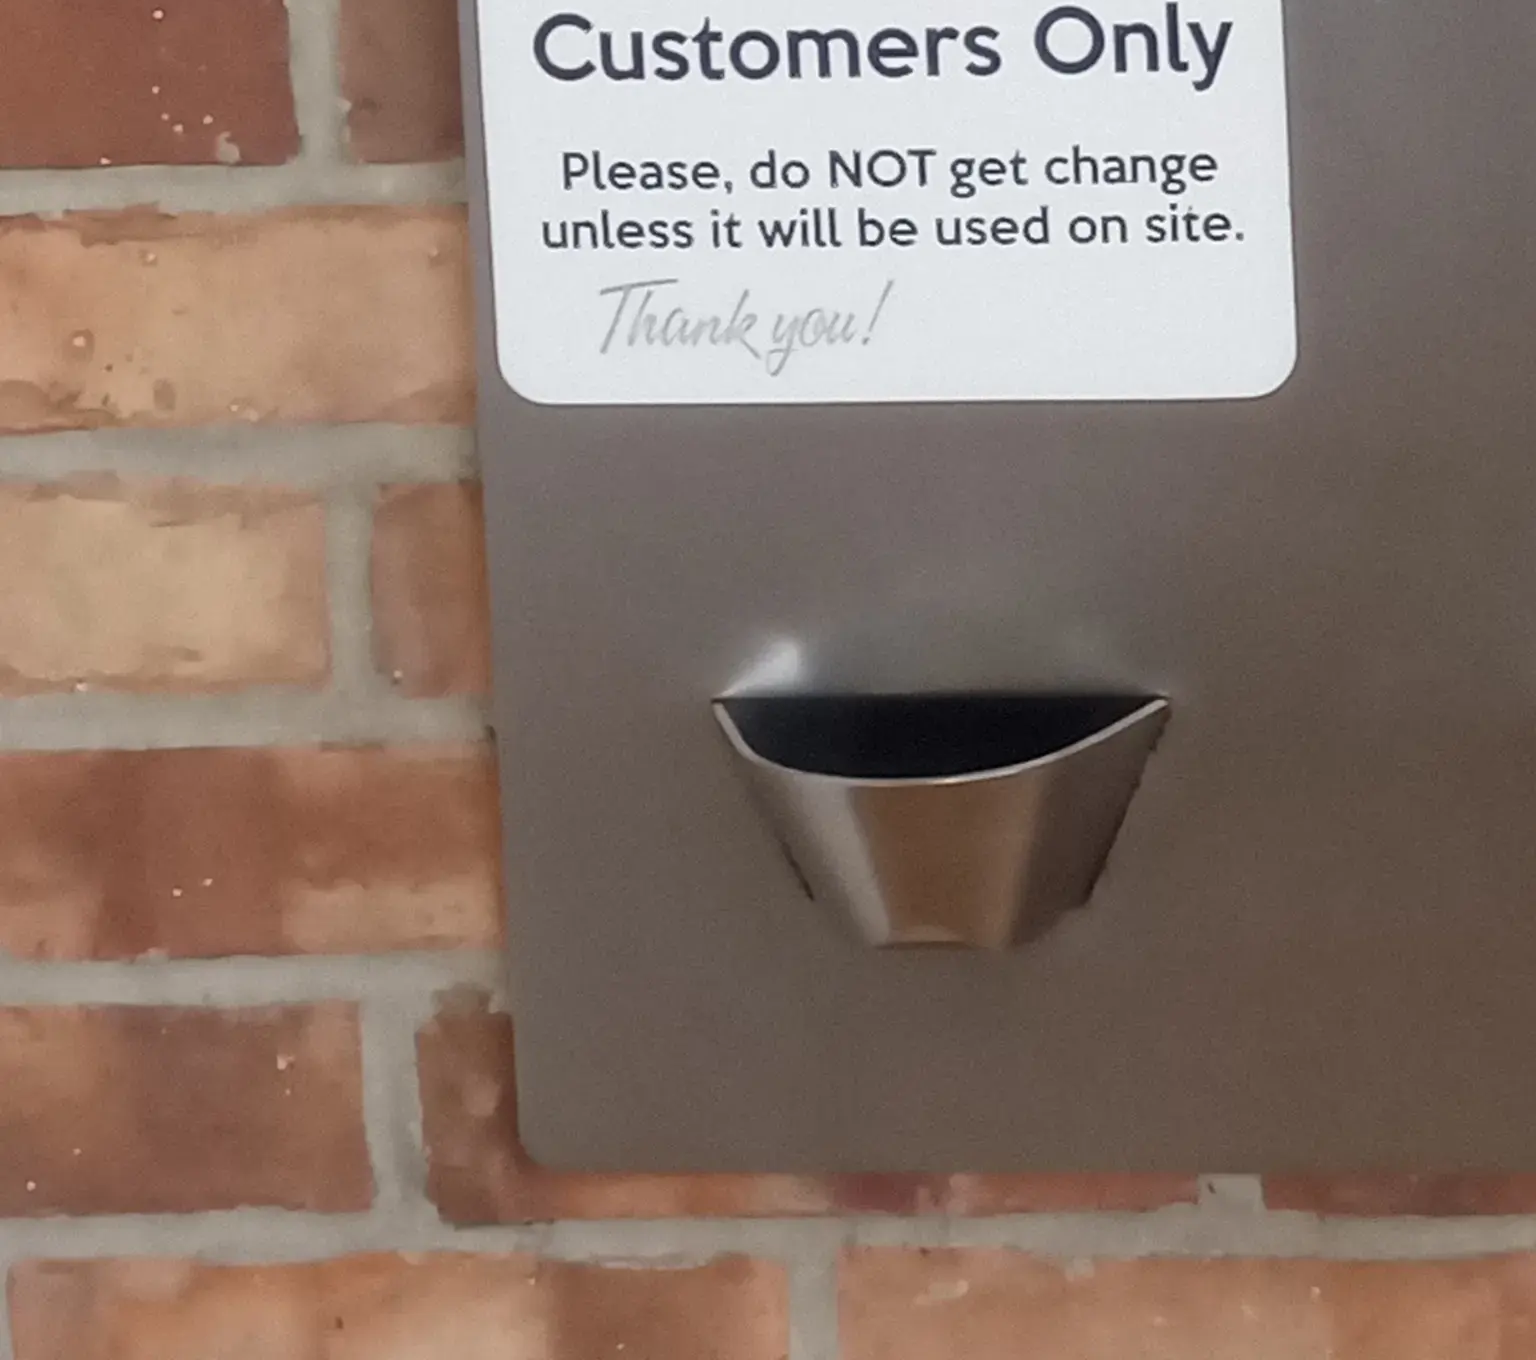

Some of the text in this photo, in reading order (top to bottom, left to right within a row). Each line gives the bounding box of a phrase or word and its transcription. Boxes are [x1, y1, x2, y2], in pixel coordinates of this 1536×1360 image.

[533, 1, 1233, 92] Customers Only
[563, 144, 1218, 199] Please, do NOT get change
[542, 202, 1244, 249] unless it will be used on site.
[599, 278, 895, 378] Thank you!
